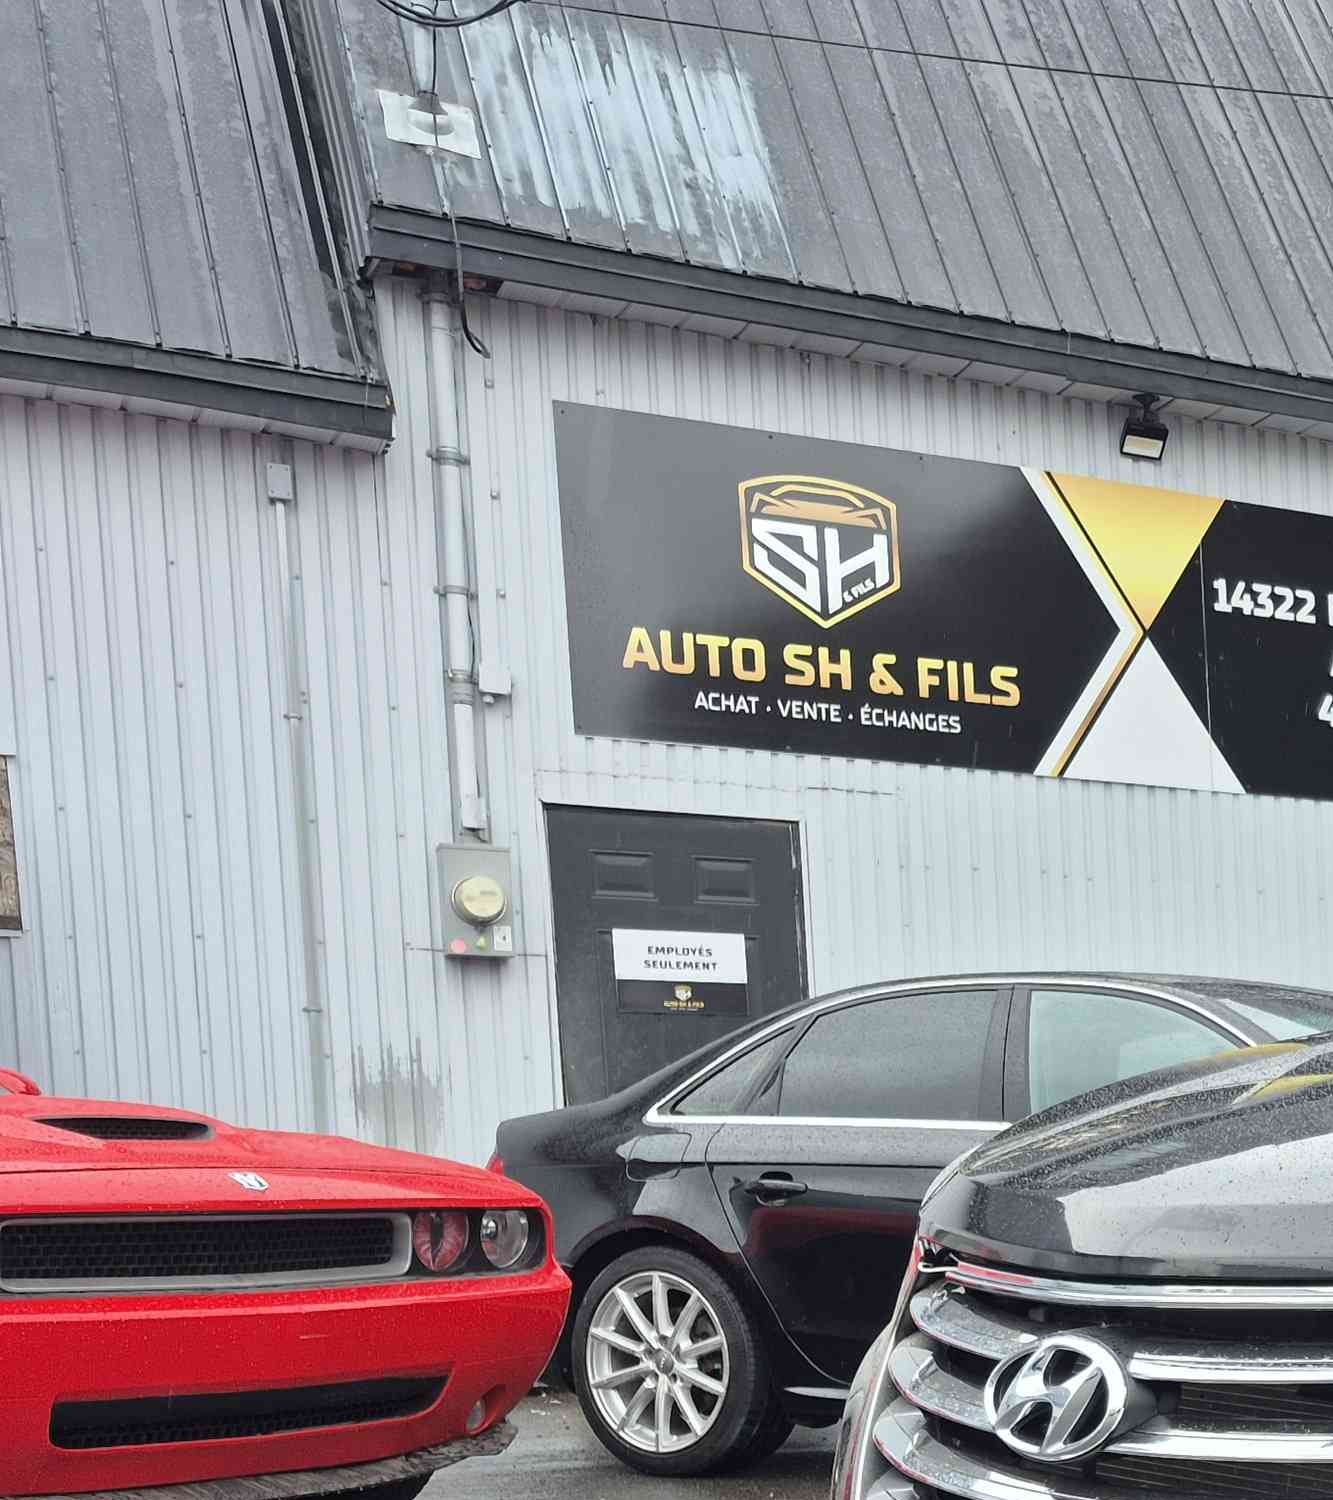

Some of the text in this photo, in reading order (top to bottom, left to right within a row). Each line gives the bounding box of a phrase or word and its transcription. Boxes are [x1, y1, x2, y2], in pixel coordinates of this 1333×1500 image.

[751, 517, 890, 615] SH
[1212, 577, 1317, 625] 14322
[621, 626, 1021, 707] AUTO SH & FILS
[694, 690, 962, 734] ACHAT VENTE ÉCHANGES
[643, 958, 718, 971] SEULEMENT
[647, 944, 713, 957] EMPLOYÉS
